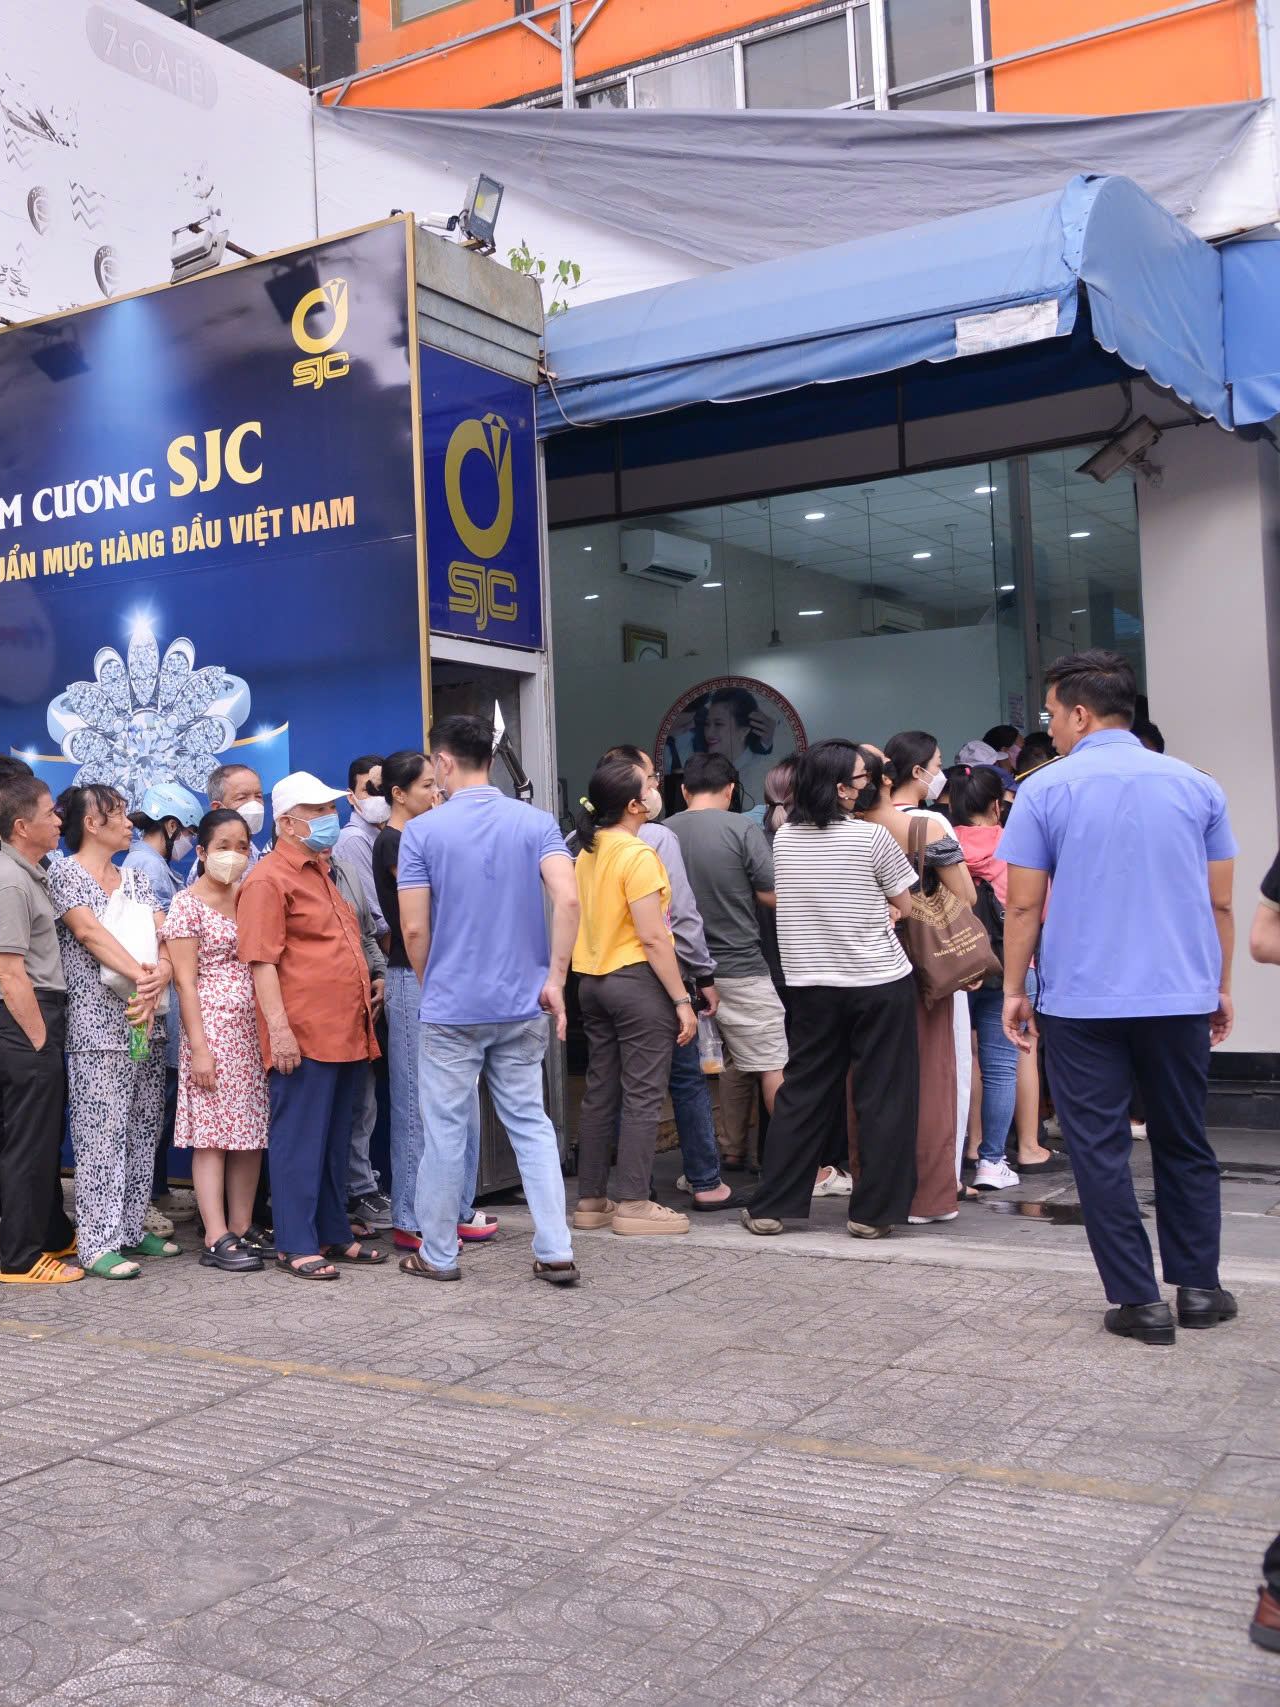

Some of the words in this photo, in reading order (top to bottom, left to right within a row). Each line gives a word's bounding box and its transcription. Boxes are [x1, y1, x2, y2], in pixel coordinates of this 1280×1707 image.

[32, 468, 155, 522] CƯƠNG
[167, 421, 263, 497] SJC
[43, 541, 93, 577] MỰC
[101, 529, 165, 566] HÀNG
[172, 512, 222, 555] ĐẦU
[228, 505, 284, 547] VIỆT
[291, 496, 355, 535] NAM
